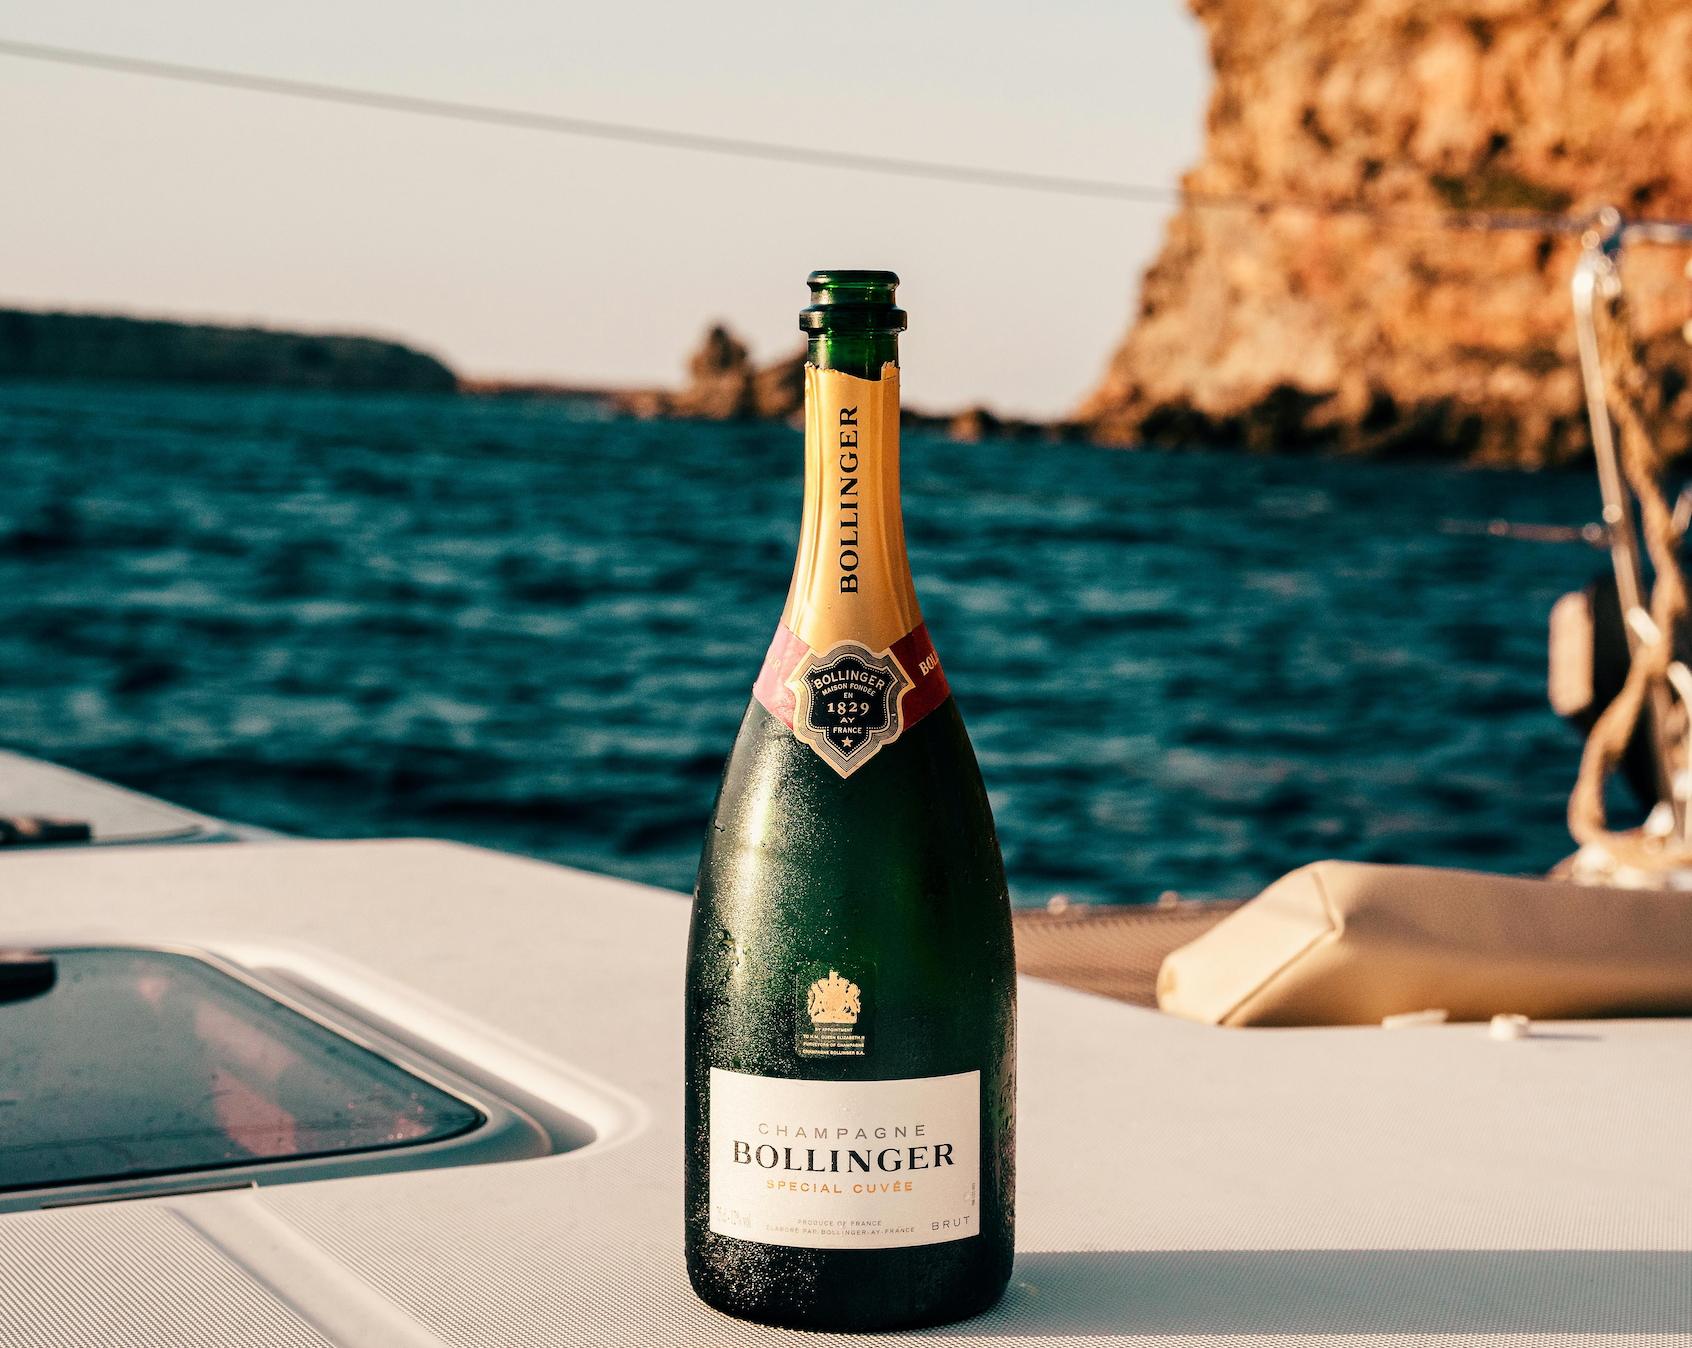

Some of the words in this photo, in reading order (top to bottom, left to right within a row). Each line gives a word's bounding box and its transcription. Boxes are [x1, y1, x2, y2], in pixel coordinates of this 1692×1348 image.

[840, 405, 859, 595] BOLLINGER
[813, 670, 885, 691] BOLLINGER
[822, 683, 847, 696] MAISON
[849, 683, 876, 697] FONDÉE
[827, 702, 870, 716] 1829
[758, 1122, 926, 1140] CHAMPAGNE
[733, 1140, 956, 1173] BOLLINGER
[766, 1179, 843, 1194] SPECIAL
[853, 1180, 913, 1194] CUVÉE
[931, 1216, 970, 1231] BRUT
